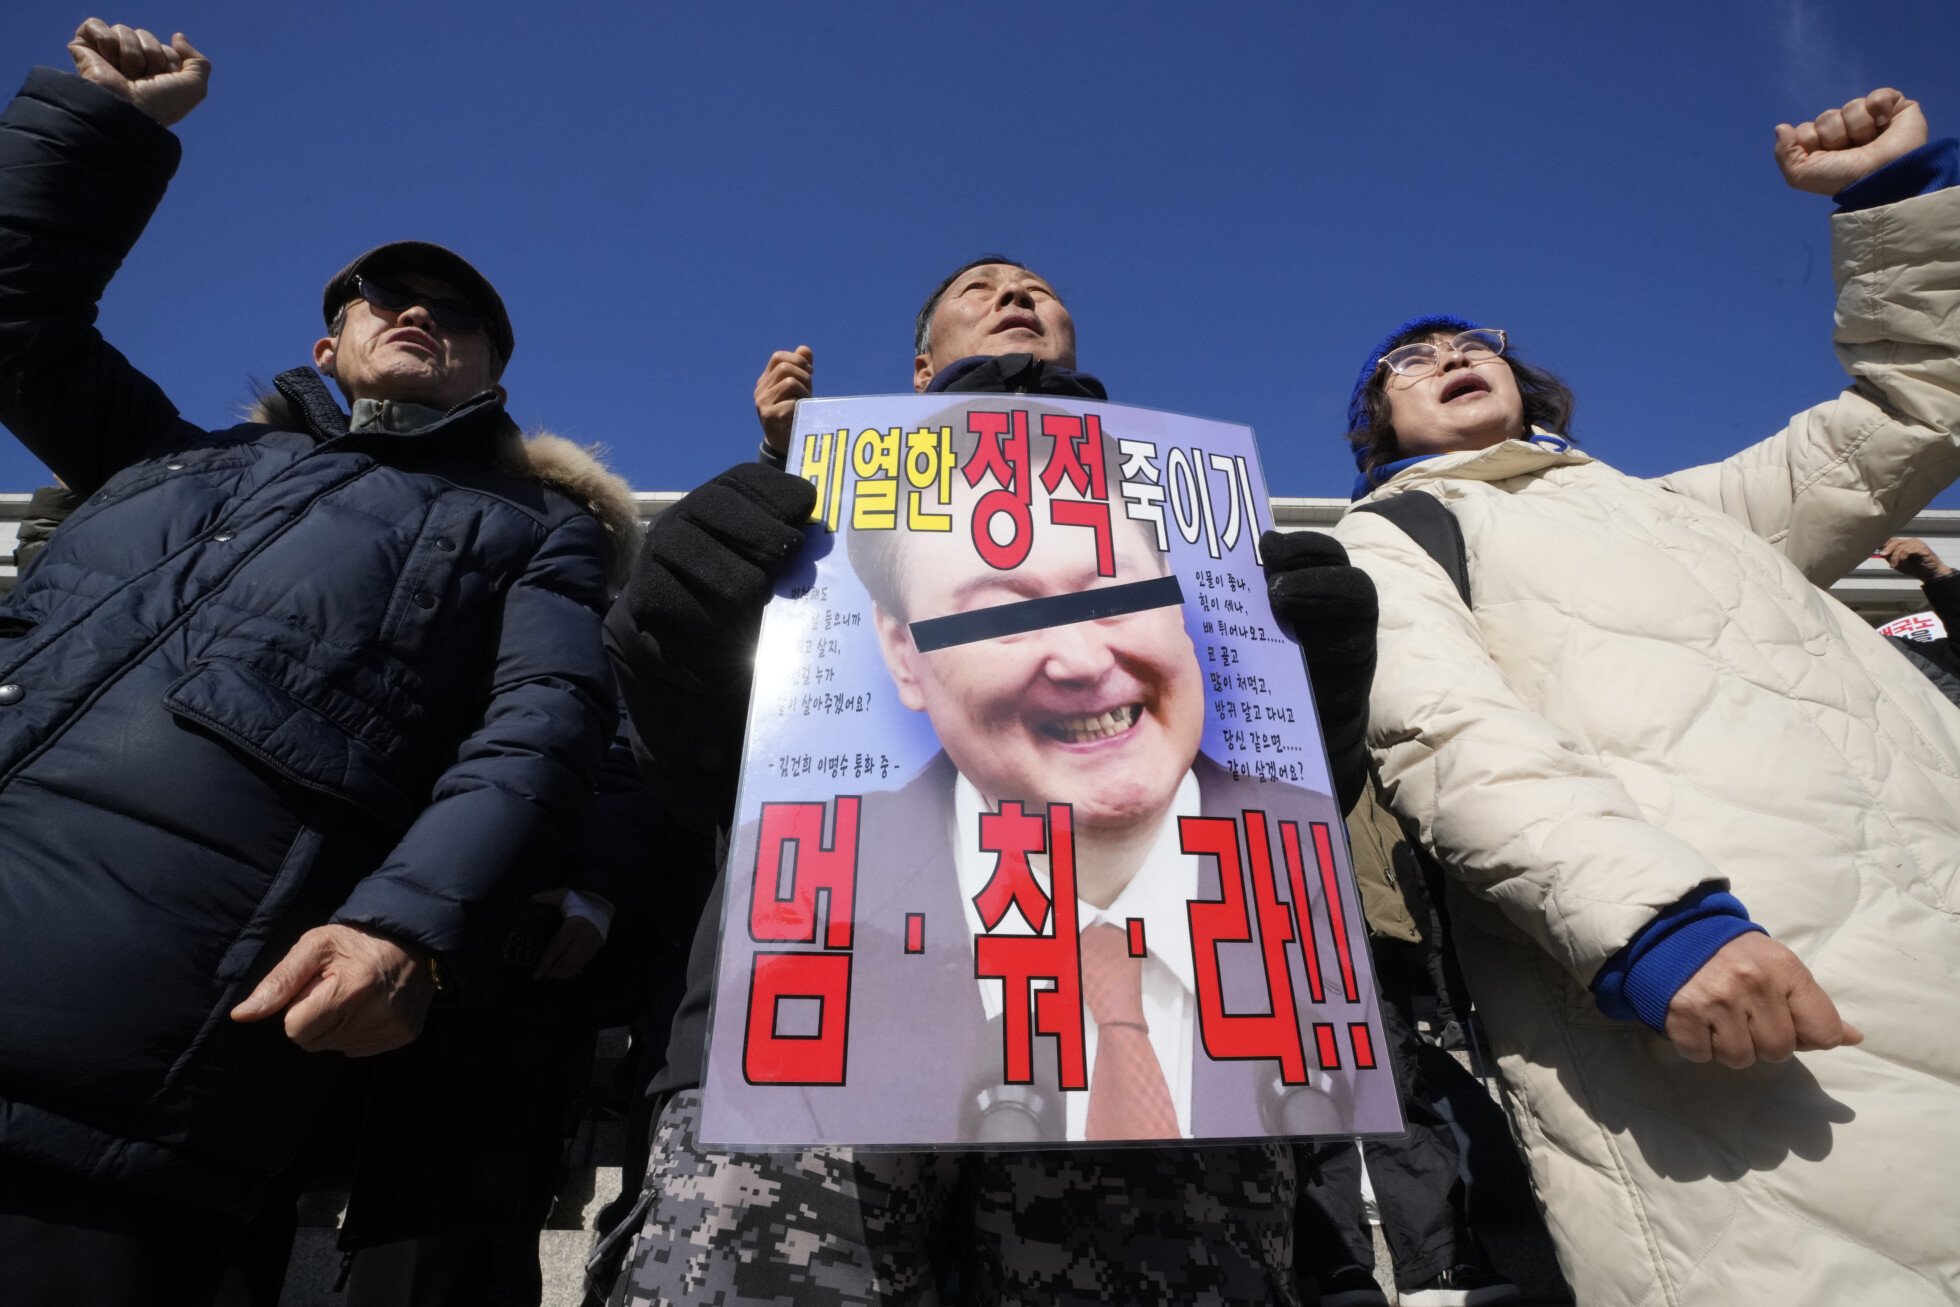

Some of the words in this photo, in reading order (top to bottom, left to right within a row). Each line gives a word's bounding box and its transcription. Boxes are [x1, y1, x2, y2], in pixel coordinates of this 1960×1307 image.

[801, 426, 957, 533] 비열한
[962, 410, 1117, 578] 정적
[1117, 438, 1264, 567] 죽이기
[1195, 570, 1224, 589] 인물이
[1226, 573, 1251, 593] 좋나,
[1198, 592, 1219, 612] 힘이
[824, 609, 861, 631] 들으니까
[1203, 622, 1213, 634] 배
[817, 637, 841, 658] 살지,
[1207, 646, 1216, 662] 코
[1220, 646, 1239, 667] 골고
[815, 665, 835, 684] 누가
[1210, 672, 1232, 693] 많이
[801, 692, 871, 716] 살아주겠어요?
[1214, 700, 1237, 720] 방귀
[1240, 702, 1262, 723] 달고
[1265, 706, 1295, 723] 다니고
[1222, 730, 1246, 751] 당신
[779, 754, 812, 778] 김건희
[817, 754, 849, 778] 이명수
[853, 753, 875, 778] 통화
[879, 754, 889, 779] 중
[1227, 759, 1251, 781] 같이
[1255, 760, 1304, 783] 살겠어요?
